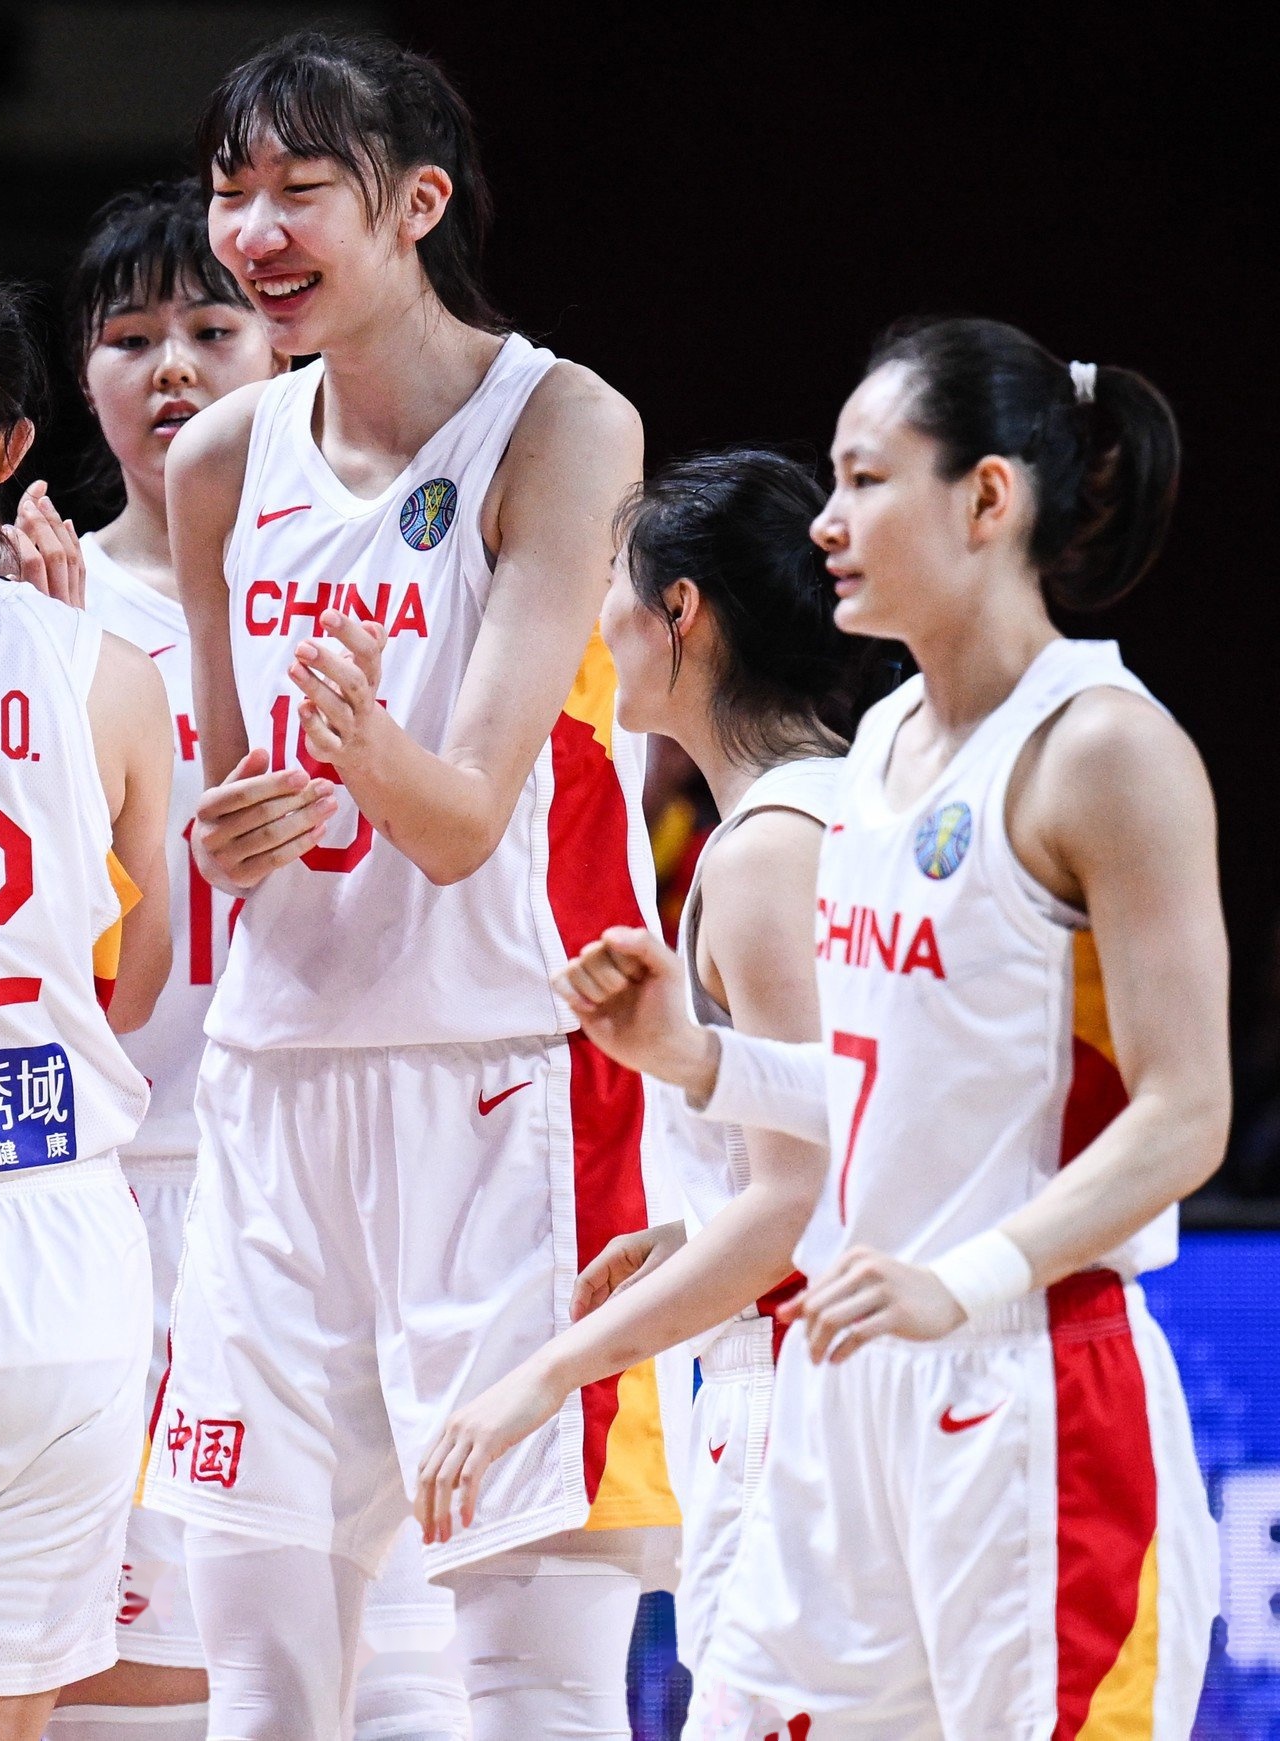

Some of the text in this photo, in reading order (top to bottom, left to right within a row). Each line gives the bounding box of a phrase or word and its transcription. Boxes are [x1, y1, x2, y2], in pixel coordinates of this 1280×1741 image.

[245, 579, 428, 639] CHINA
[832, 1030, 879, 1228] 7
[167, 1409, 246, 1489] 中国
